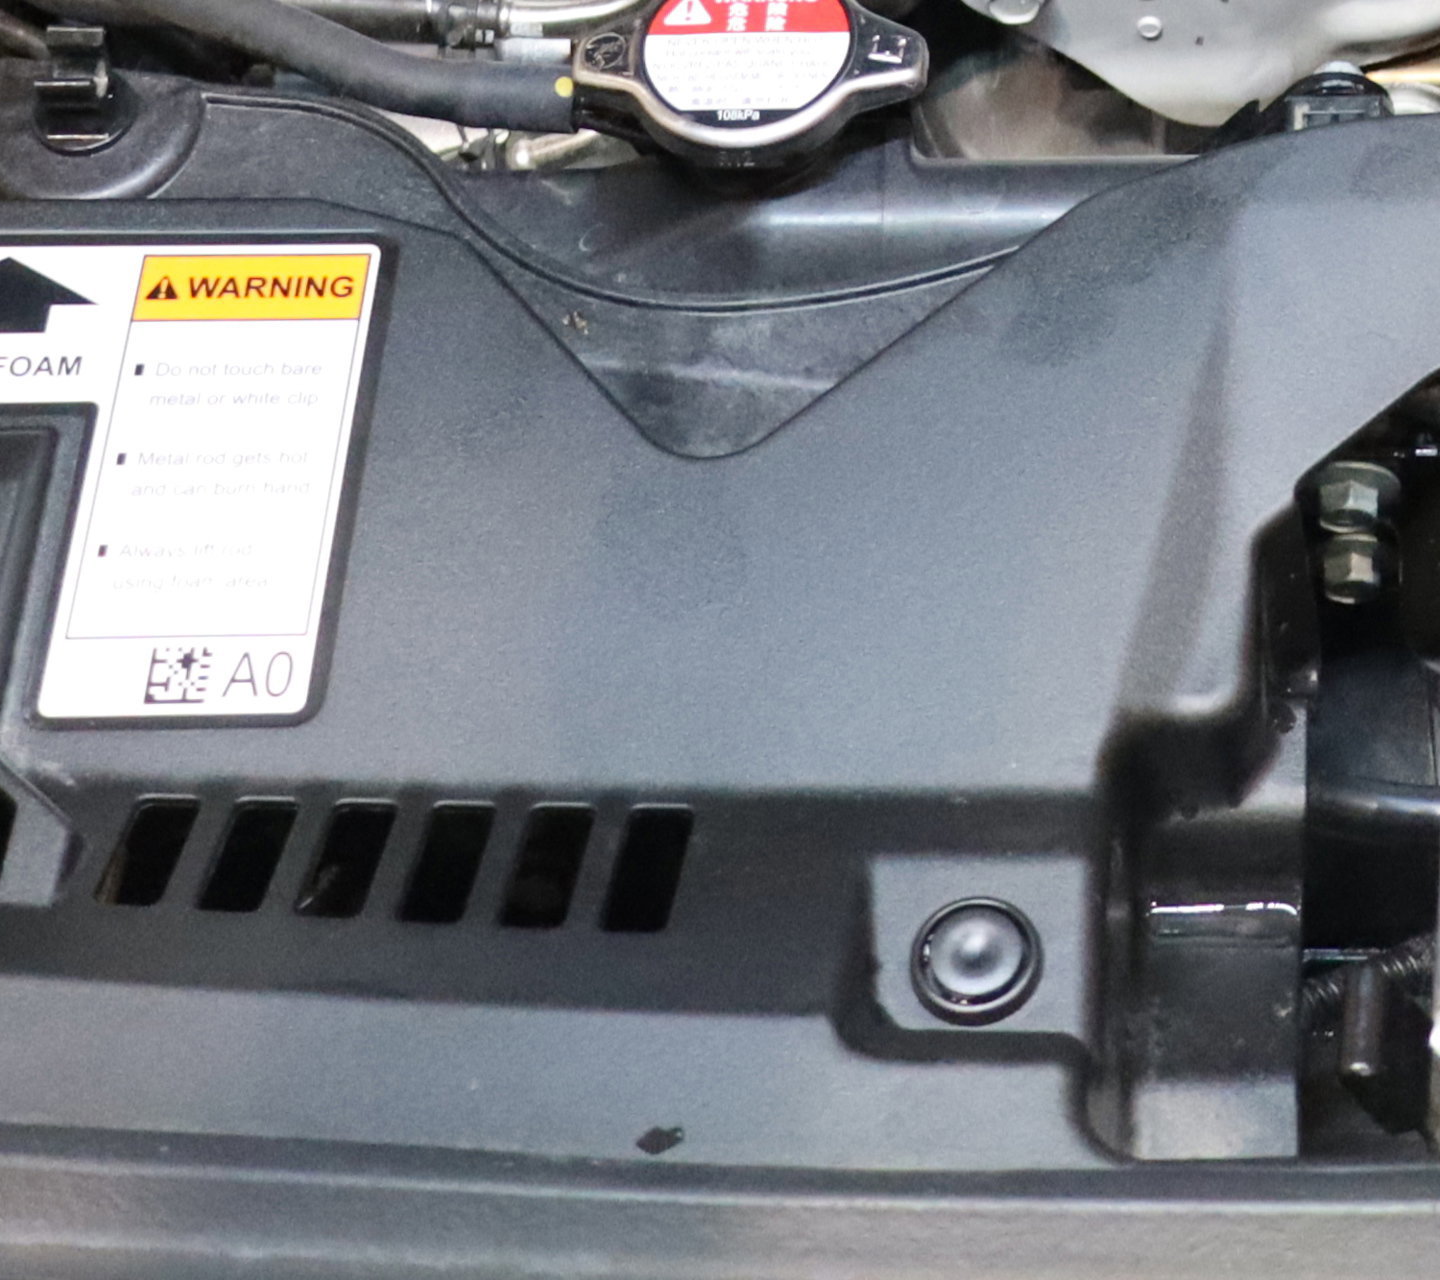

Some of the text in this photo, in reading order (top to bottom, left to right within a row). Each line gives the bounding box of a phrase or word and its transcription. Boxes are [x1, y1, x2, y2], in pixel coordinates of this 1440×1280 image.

[716, 109, 761, 122] 108kPa
[188, 275, 355, 299] WARNING
[155, 362, 323, 377] Do not touch bare
[149, 392, 320, 408] metal or white clip
[137, 451, 309, 468] Metal rod gets hot
[131, 483, 166, 497] and
[214, 483, 256, 496] burn
[263, 483, 311, 496] hand
[221, 651, 295, 699] A0
